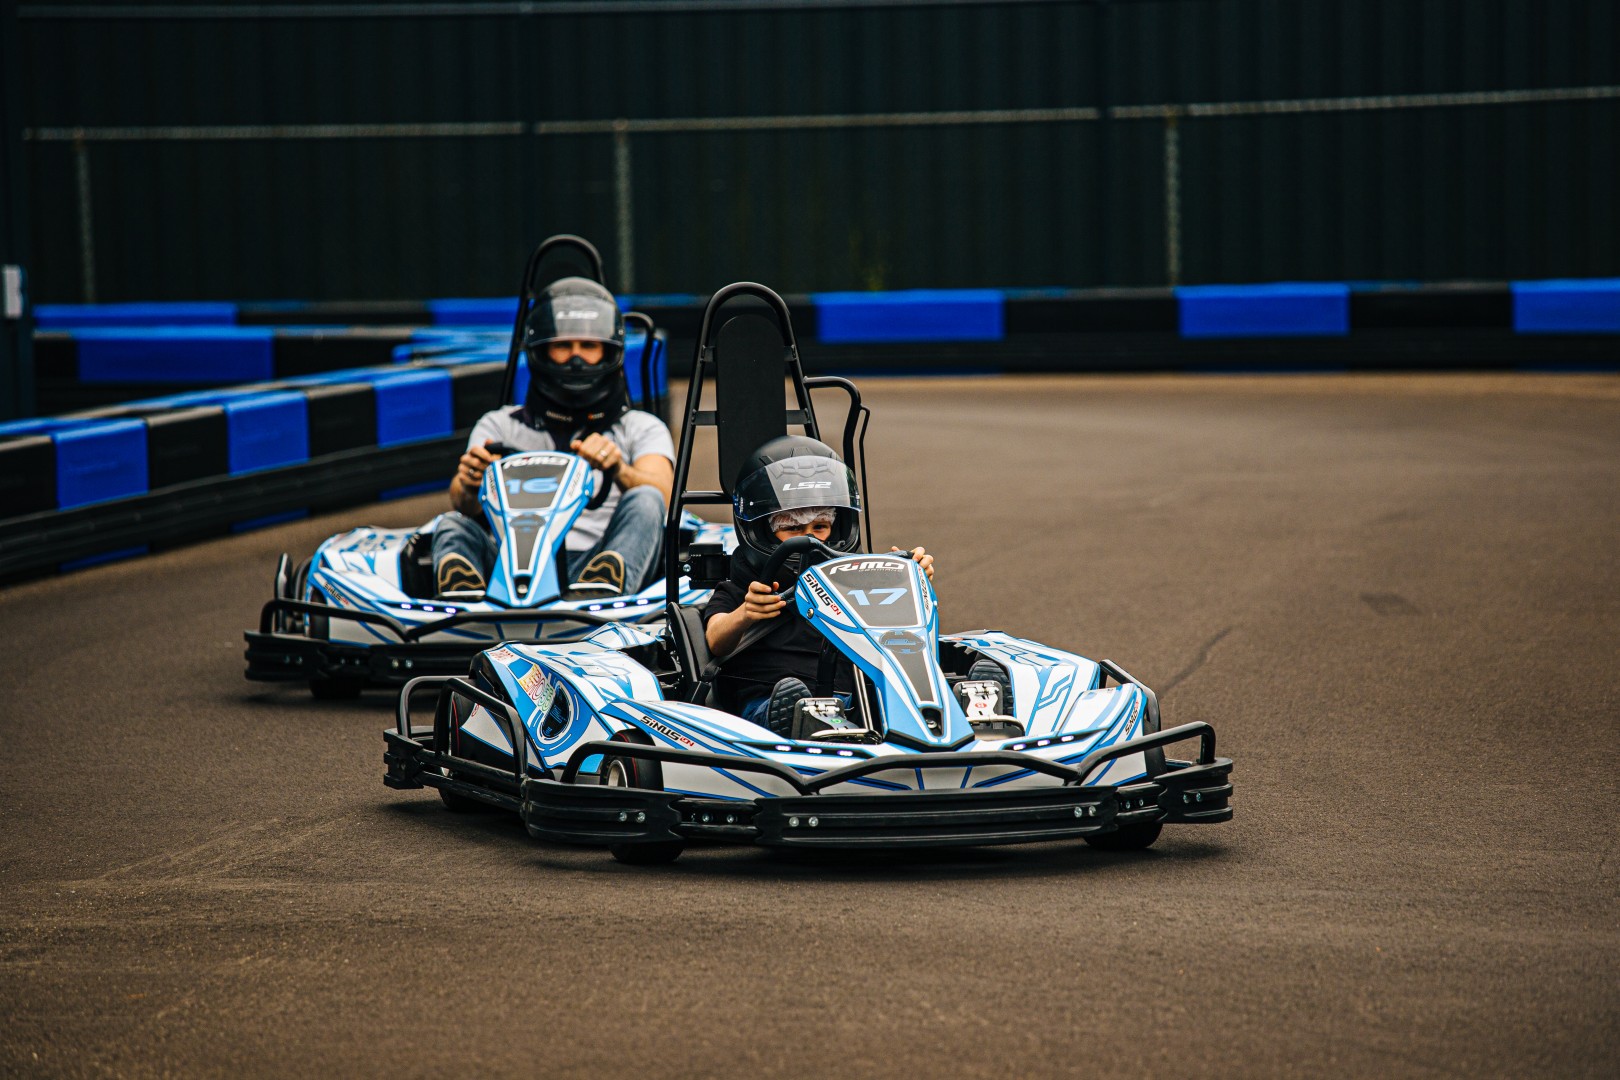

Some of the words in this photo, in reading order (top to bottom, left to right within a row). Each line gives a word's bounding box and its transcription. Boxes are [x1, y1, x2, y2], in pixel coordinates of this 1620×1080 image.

[505, 477, 560, 495] 16
[782, 481, 832, 491] LS2
[847, 588, 908, 606] 17
